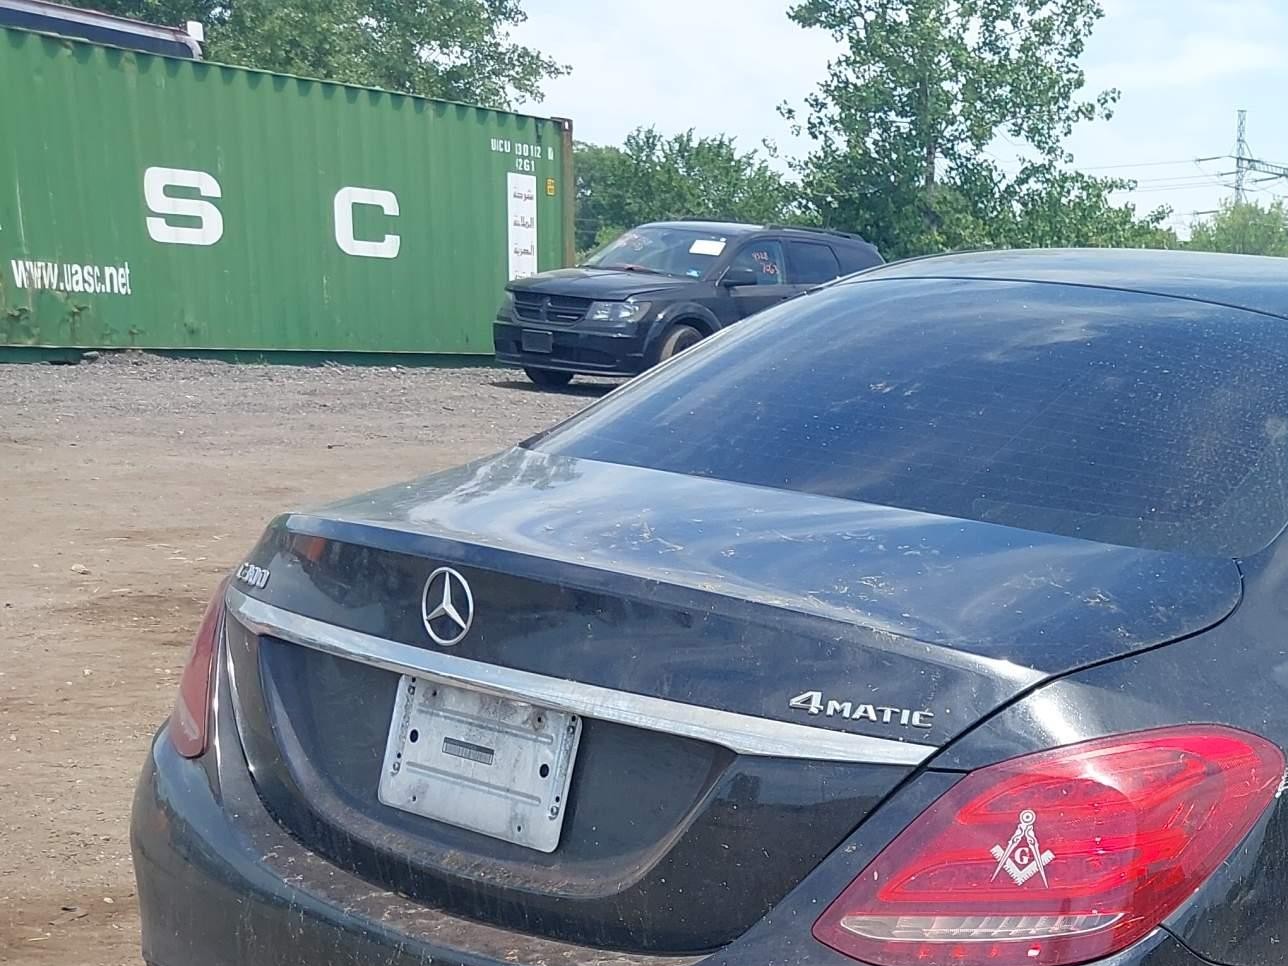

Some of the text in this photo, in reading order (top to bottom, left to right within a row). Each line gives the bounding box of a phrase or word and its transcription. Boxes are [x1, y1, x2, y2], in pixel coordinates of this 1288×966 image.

[144, 167, 400, 258] S C
[11, 259, 132, 295] www.uasc.net
[789, 691, 935, 728] 4MATIC
[1014, 847, 1031, 865] G
